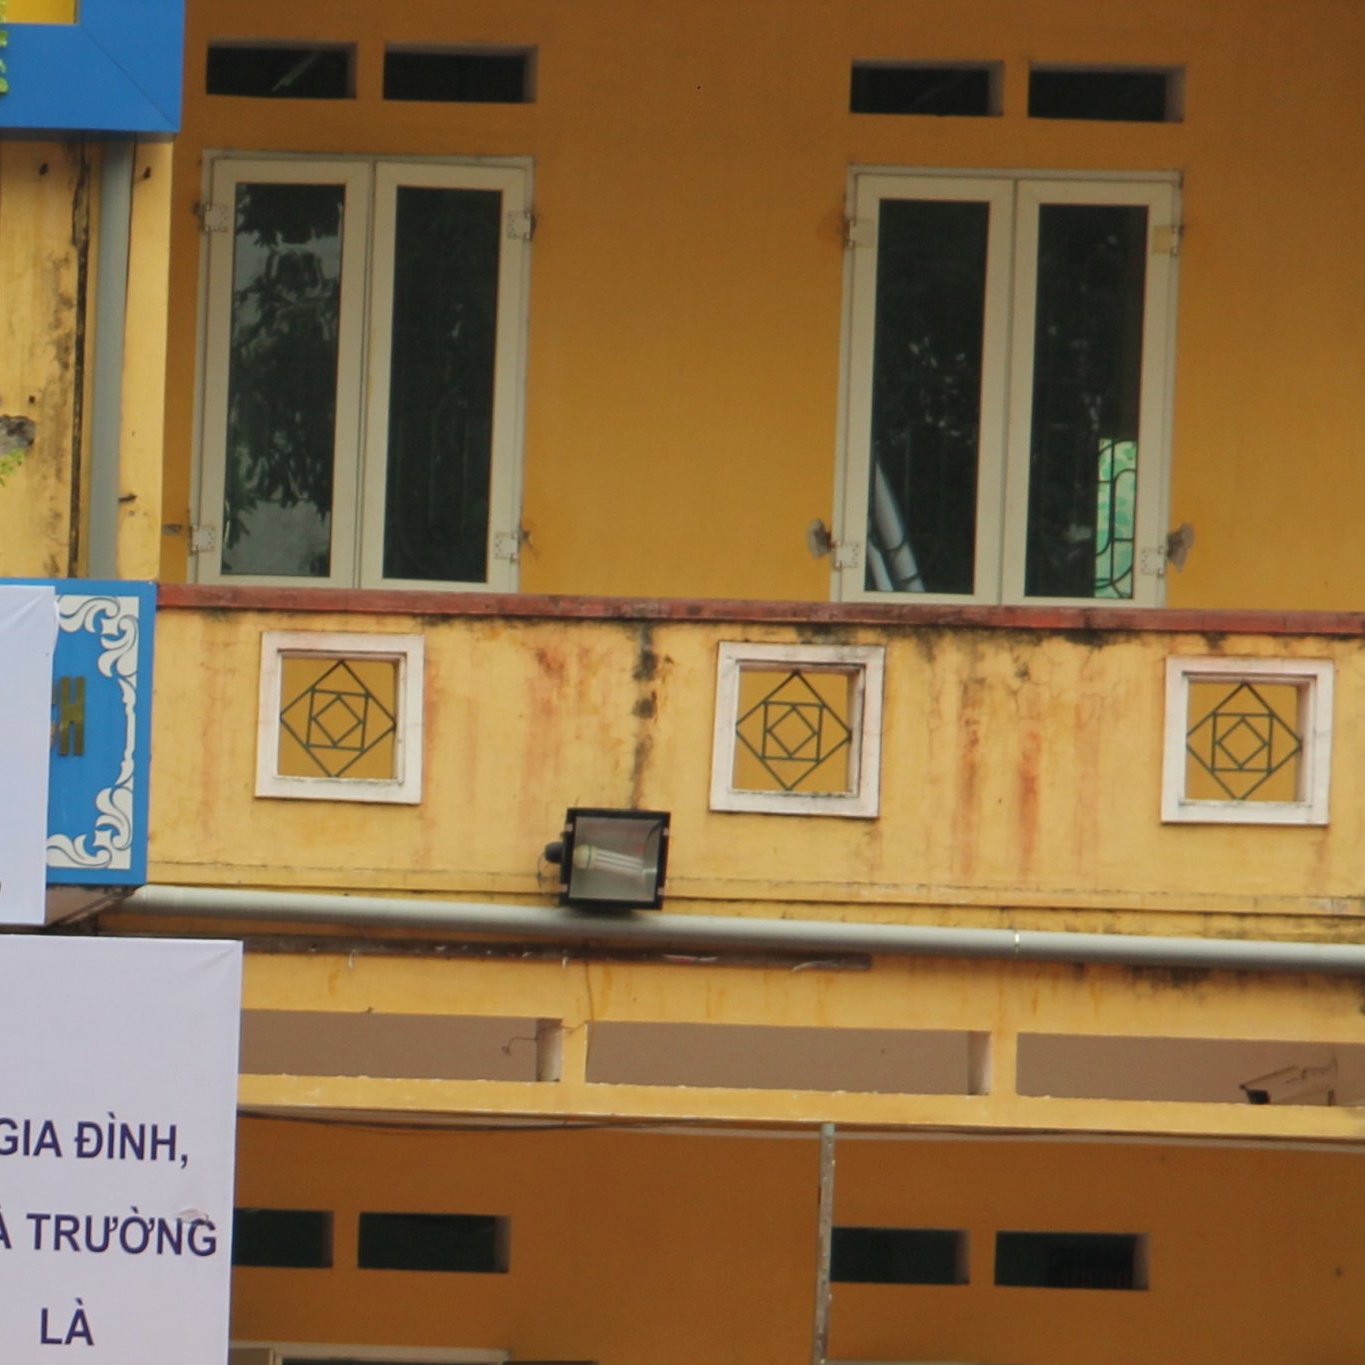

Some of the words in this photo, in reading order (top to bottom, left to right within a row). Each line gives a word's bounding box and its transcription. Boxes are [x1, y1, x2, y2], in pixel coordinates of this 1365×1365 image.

[74, 1112, 187, 1168] ĐÌNH,
[27, 1207, 216, 1256] TRƯỜNG
[41, 1298, 94, 1346] LÀ
